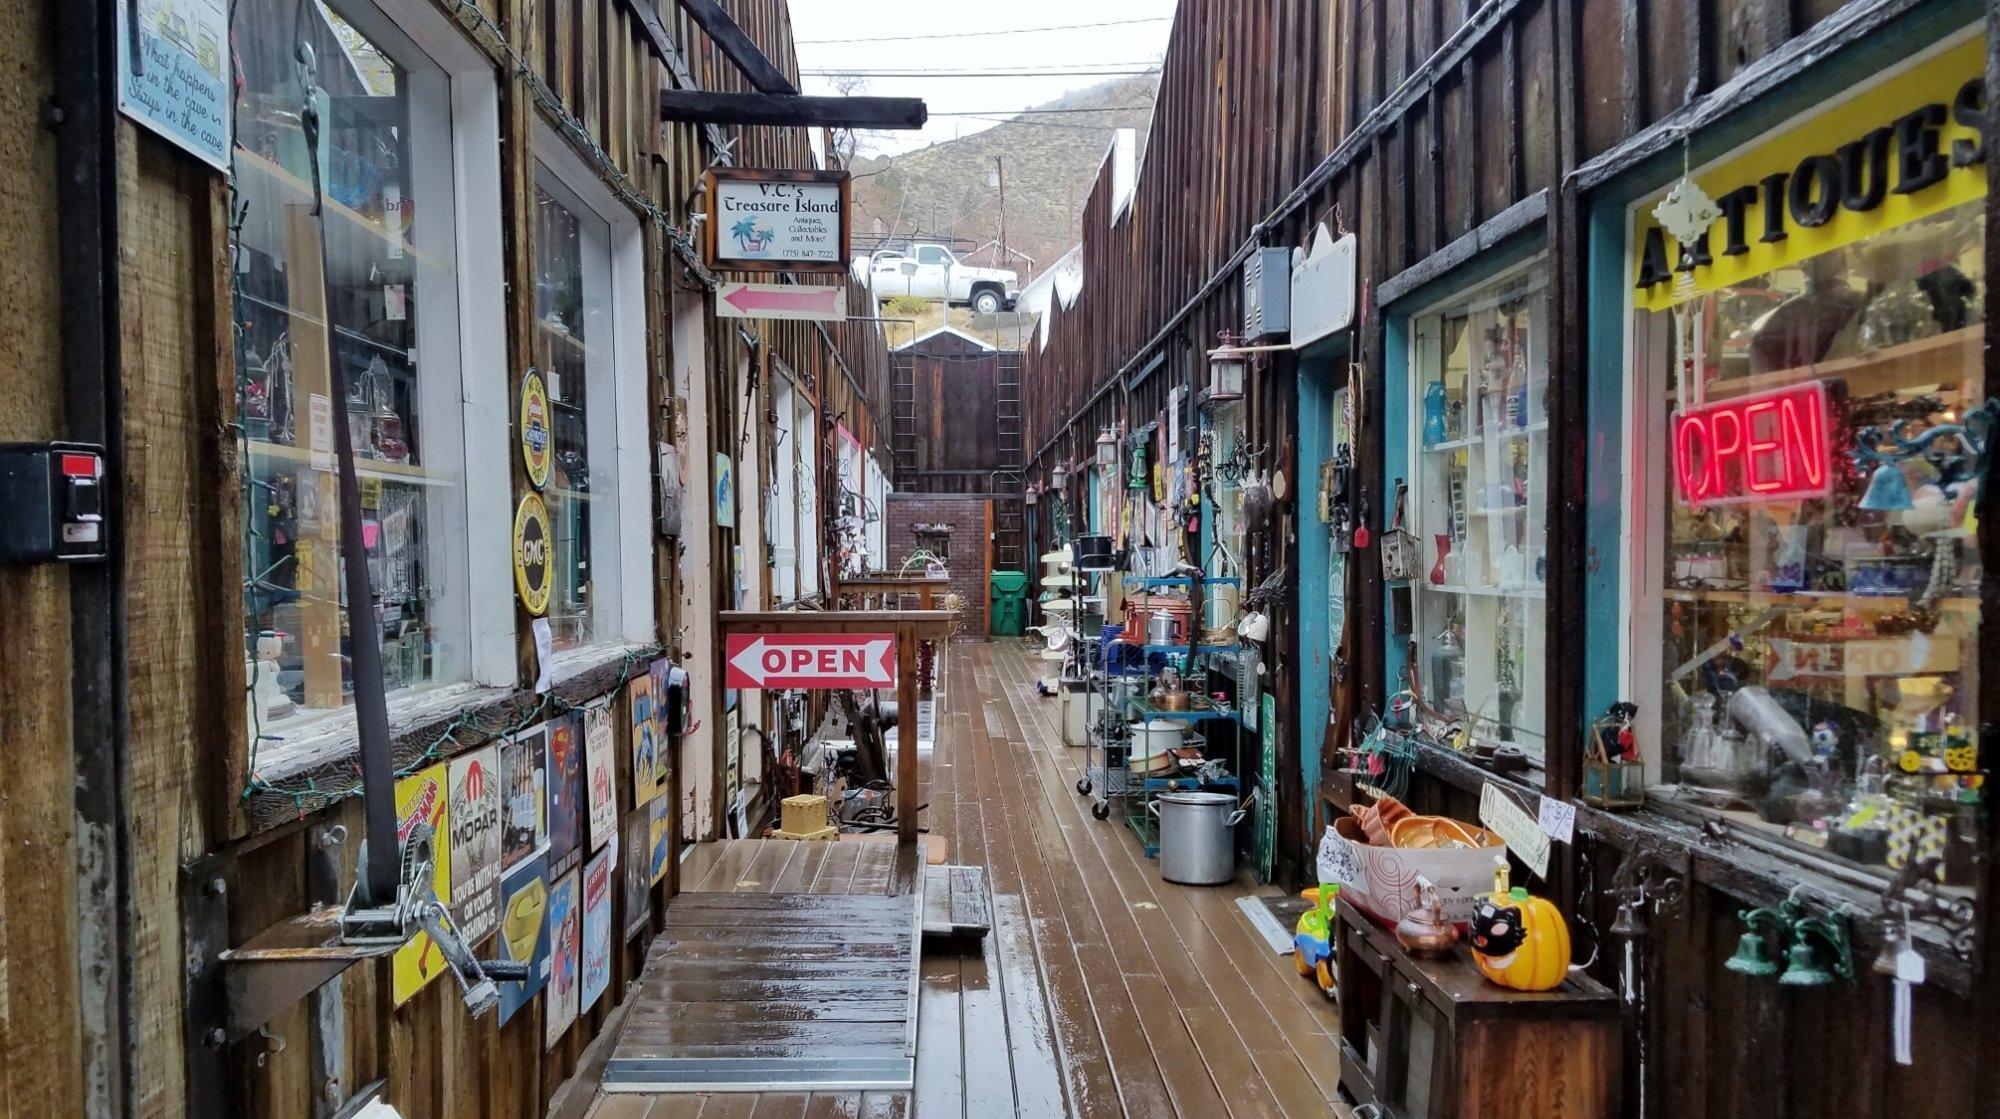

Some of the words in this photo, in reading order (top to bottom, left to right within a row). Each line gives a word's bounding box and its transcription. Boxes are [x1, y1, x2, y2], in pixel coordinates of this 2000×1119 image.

[140, 33, 170, 70] What
[174, 51, 217, 103] happens
[147, 72, 161, 88] in
[165, 76, 181, 100] the
[185, 96, 208, 118] cave
[128, 76, 161, 116] Stays
[166, 101, 177, 123] in
[181, 108, 198, 135] the
[201, 129, 223, 151] cave
[759, 182, 804, 198] V.C.'s
[724, 197, 790, 212] Treasure
[795, 198, 838, 213] Island
[782, 249, 799, 257] (775)
[1679, 393, 1821, 498] OPEN
[523, 538, 545, 567] GMC
[761, 649, 866, 673] OPEN
[453, 808, 498, 851] MOPAR
[475, 865, 492, 892] WITH
[462, 911, 488, 942] BEHIND
[488, 907, 496, 927] US
[464, 902, 473, 921] OR
